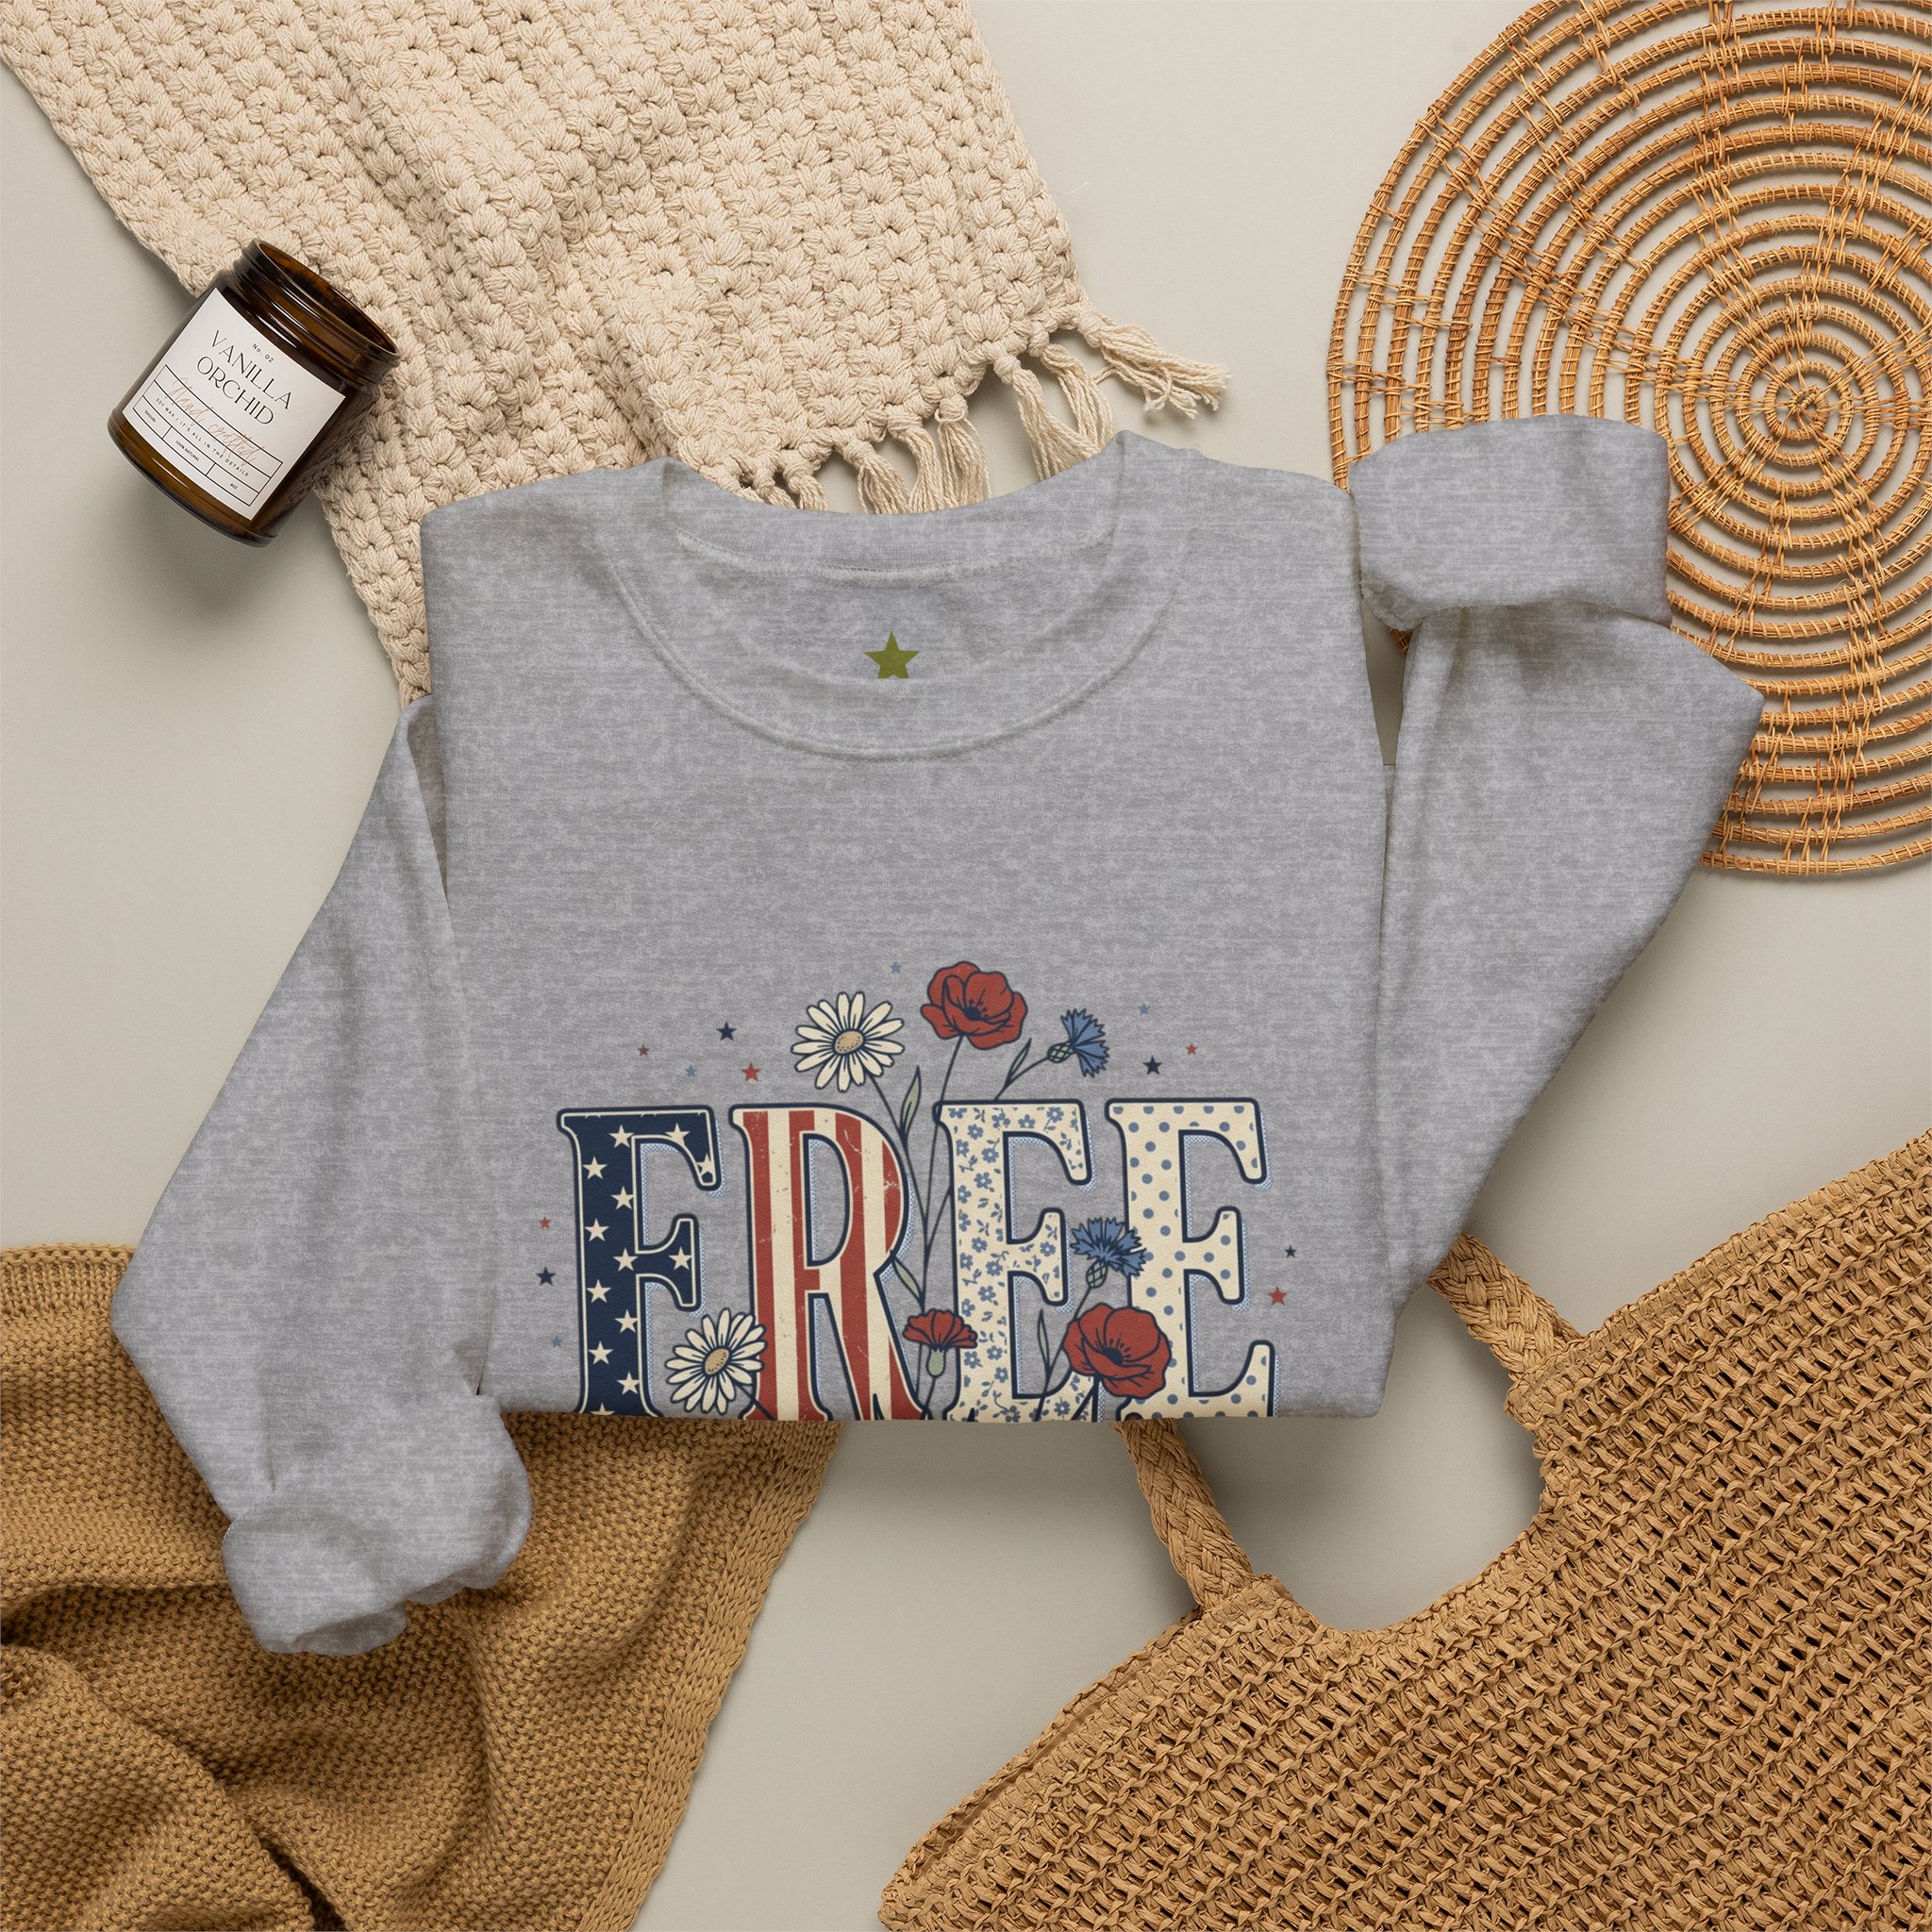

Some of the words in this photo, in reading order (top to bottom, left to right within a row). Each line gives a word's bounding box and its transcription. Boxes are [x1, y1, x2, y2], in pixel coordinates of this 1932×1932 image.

[197, 356, 274, 425] ORCHID
[211, 329, 291, 409] VANILLA
[264, 354, 275, 363] 02
[156, 398, 165, 407] SOY
[192, 432, 202, 442] ALL
[212, 448, 224, 458] THE
[225, 458, 249, 477] DETAILS
[558, 1097, 1283, 1422] FREE
